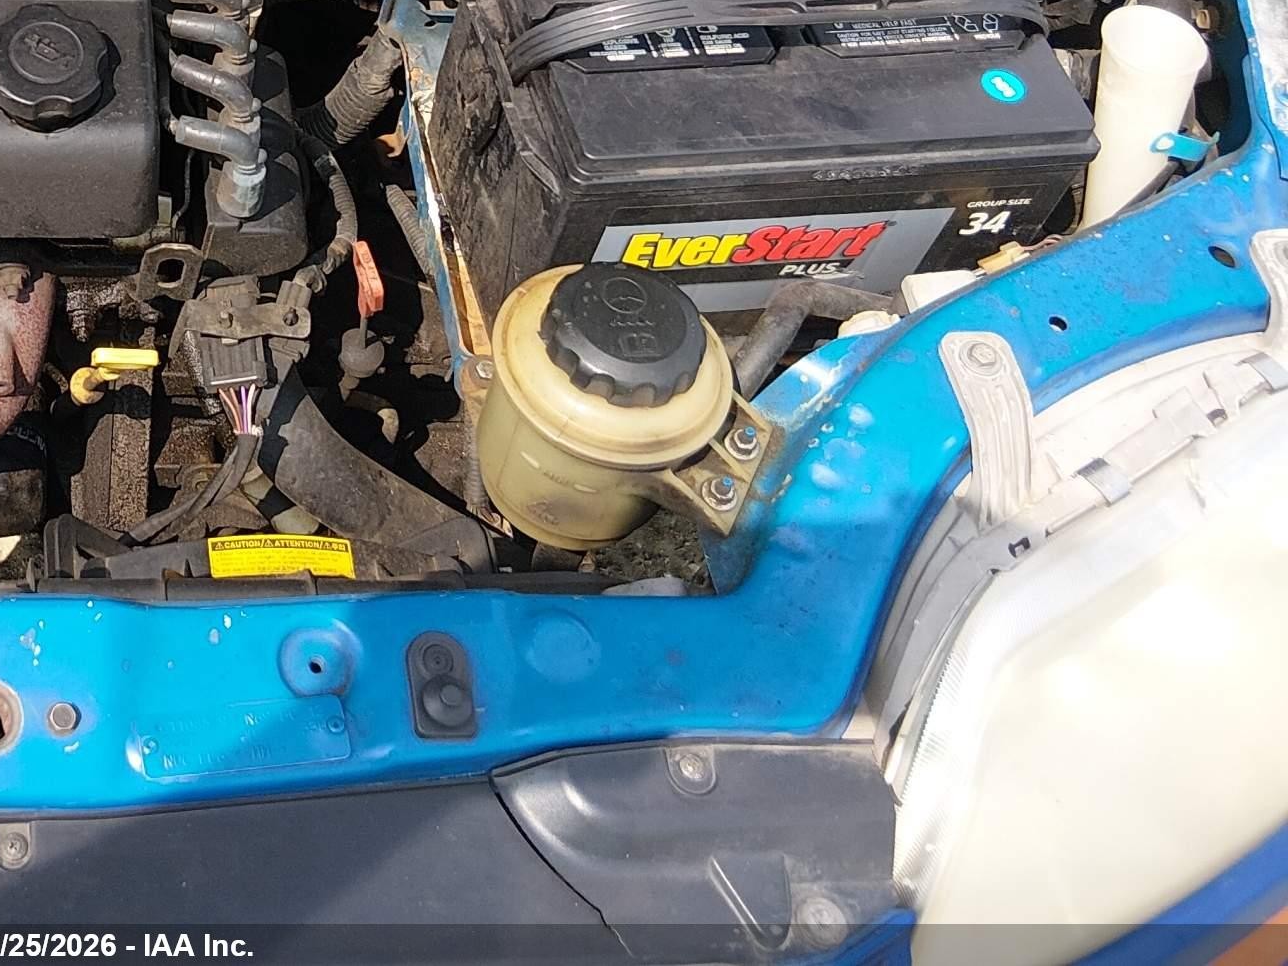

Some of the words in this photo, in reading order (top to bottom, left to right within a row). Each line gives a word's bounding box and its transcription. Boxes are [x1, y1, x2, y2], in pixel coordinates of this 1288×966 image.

[966, 200, 1006, 209] GROUP
[1006, 198, 1033, 206] SIZE
[958, 210, 1012, 235] 34
[620, 219, 888, 270] EverStart
[778, 262, 841, 276] PLUS
